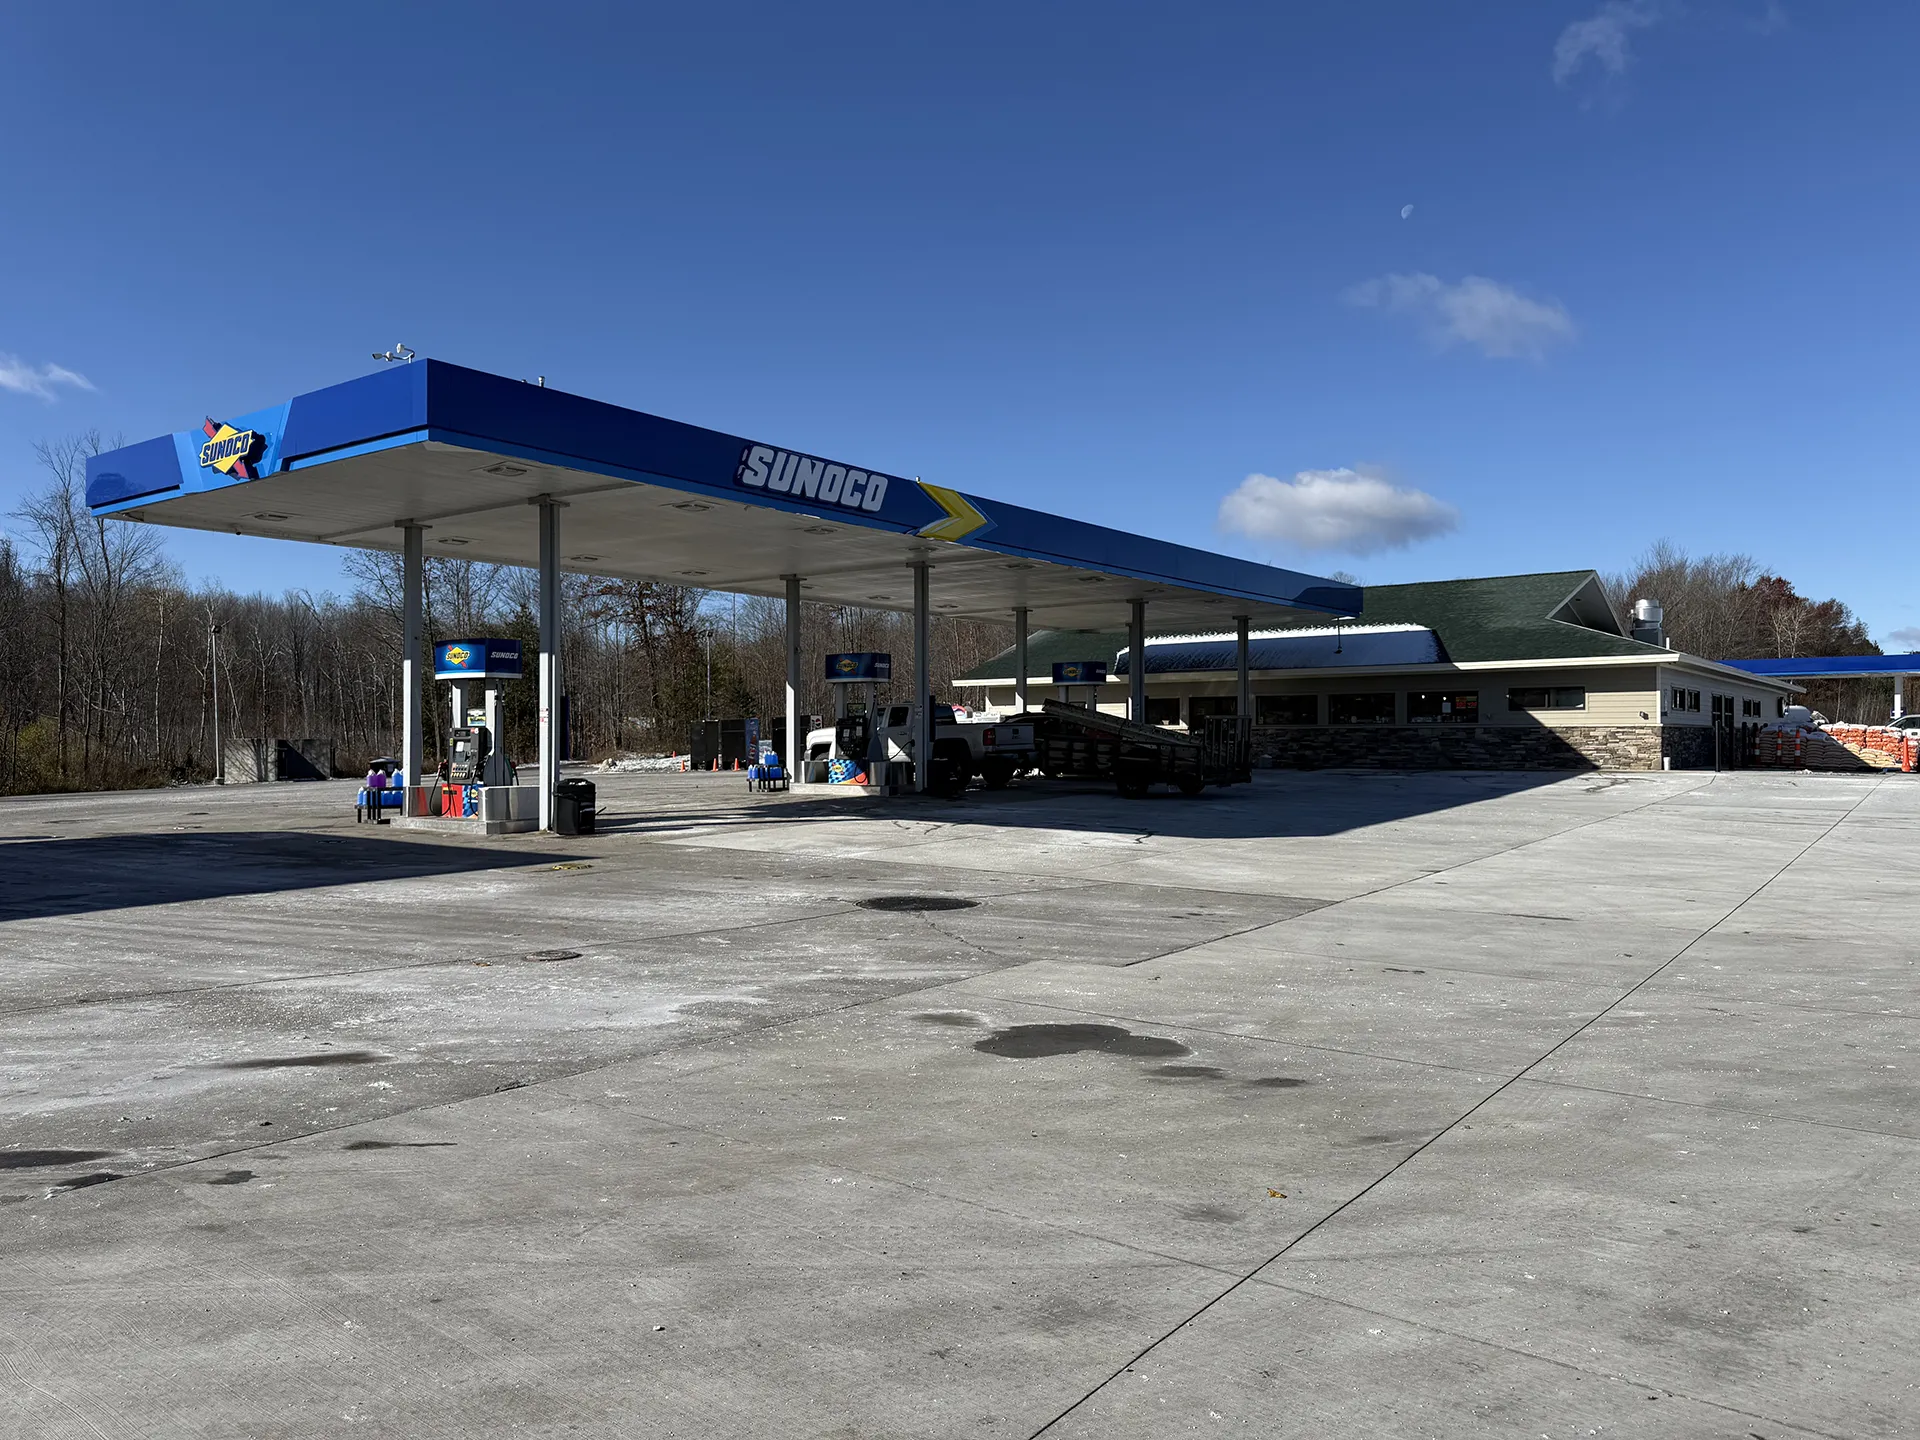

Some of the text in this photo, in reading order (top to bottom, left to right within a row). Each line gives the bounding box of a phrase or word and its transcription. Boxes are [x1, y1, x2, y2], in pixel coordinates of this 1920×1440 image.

[201, 433, 250, 465] SUNOCO
[742, 445, 889, 512] SUNOCO
[446, 651, 469, 660] SUNOCO
[490, 651, 519, 660] SUNOCO
